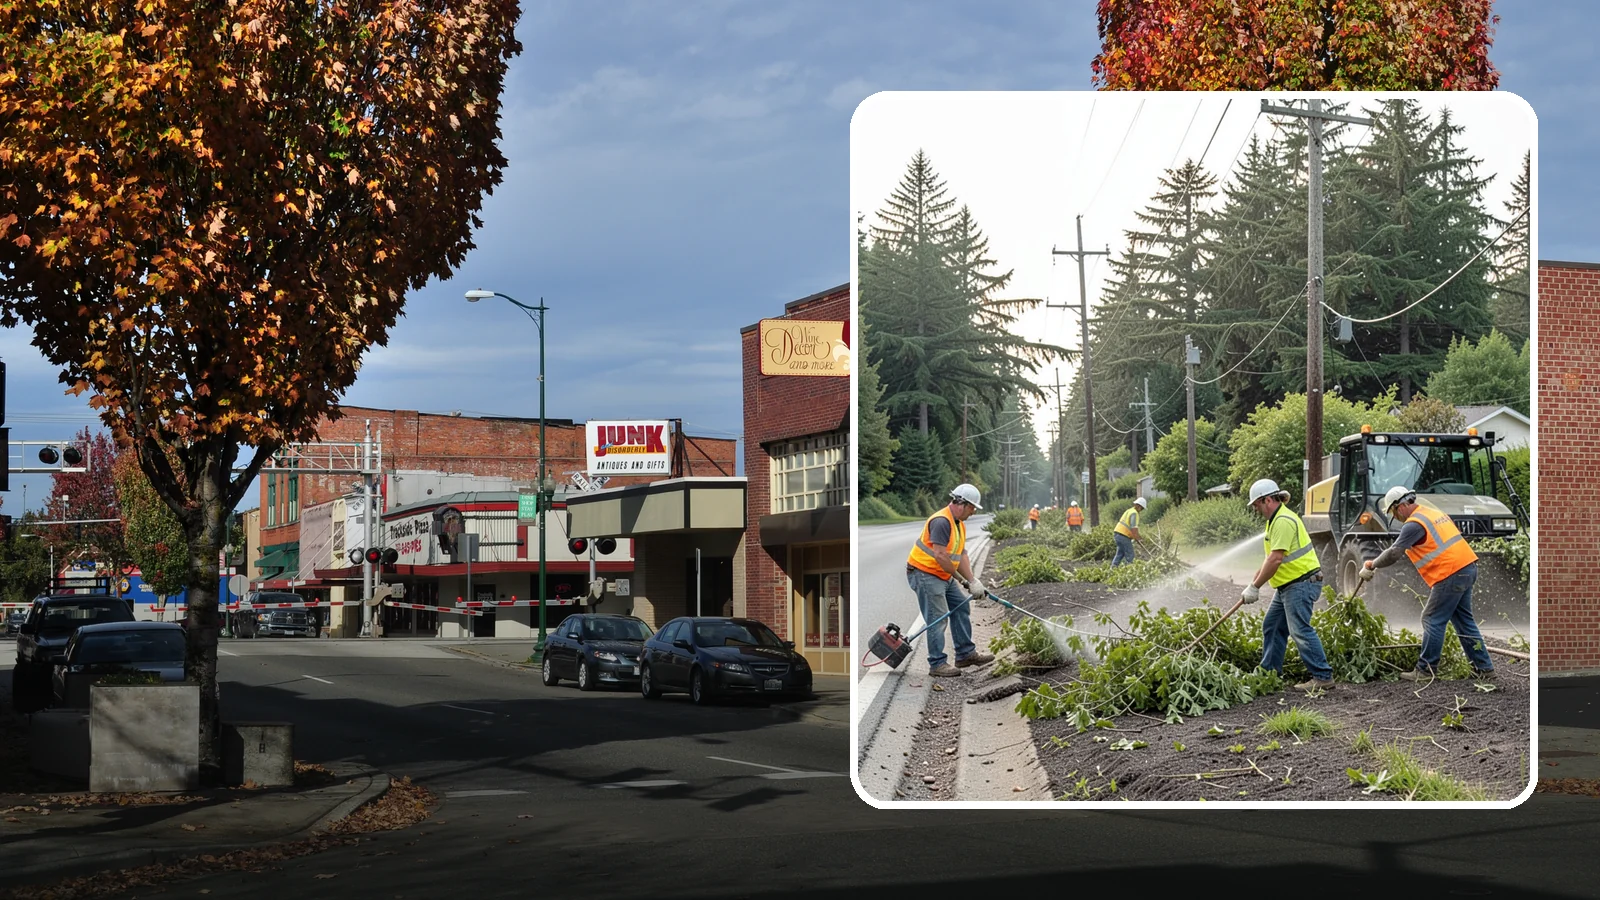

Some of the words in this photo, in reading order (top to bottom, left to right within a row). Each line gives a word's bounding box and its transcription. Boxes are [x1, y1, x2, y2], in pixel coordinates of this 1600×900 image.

[595, 425, 664, 457] JUNK
[607, 446, 645, 454] DISORDERLY
[597, 461, 628, 470] ANTIQUES
[631, 461, 644, 470] AND
[647, 460, 665, 469] GIFTS
[390, 521, 413, 539] Trackside
[414, 520, 429, 534] Pizza
